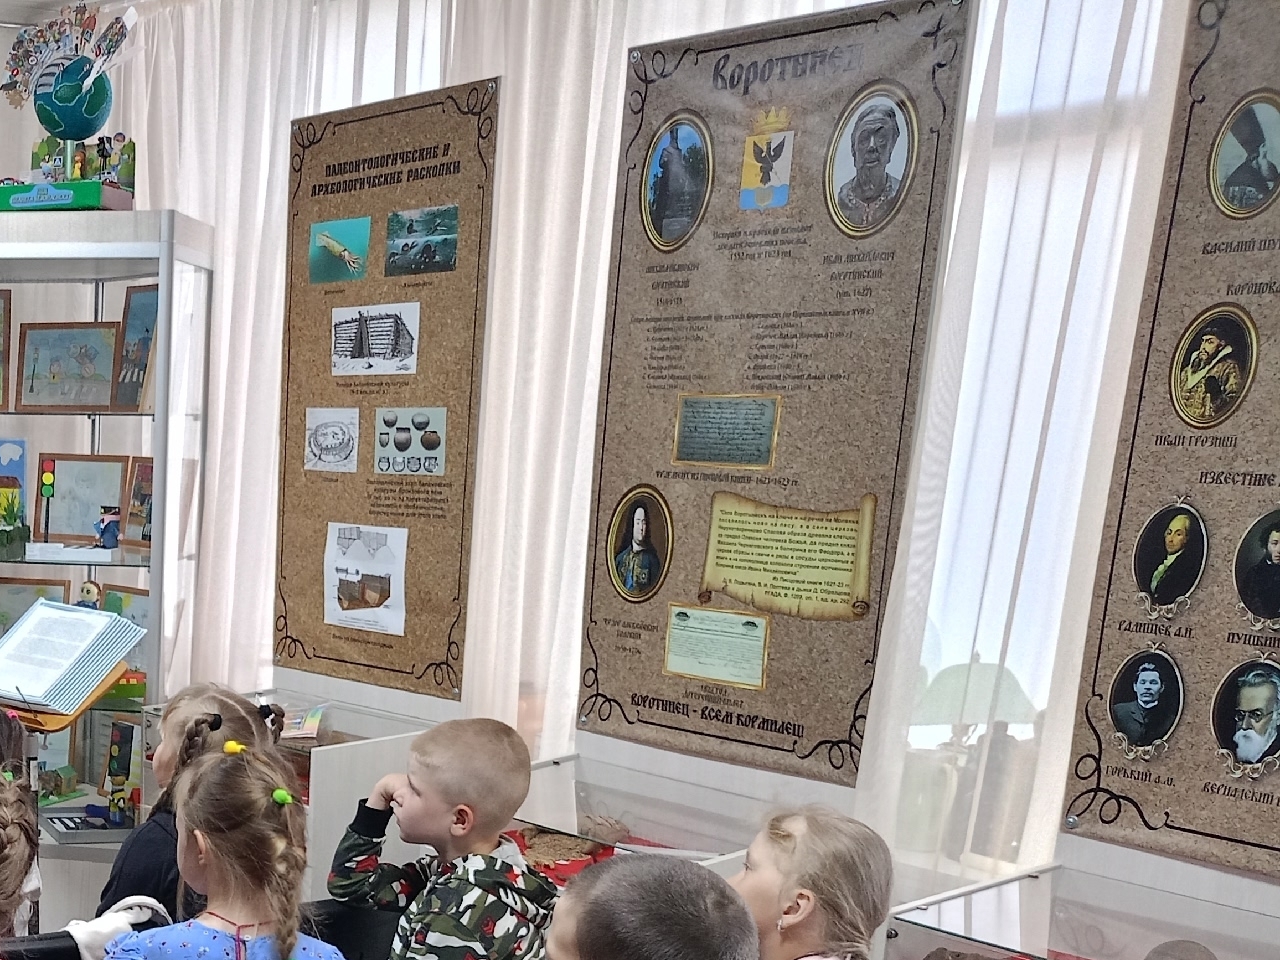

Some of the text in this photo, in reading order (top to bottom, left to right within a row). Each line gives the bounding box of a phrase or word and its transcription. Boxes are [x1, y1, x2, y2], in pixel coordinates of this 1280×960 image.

[325, 143, 451, 177] ПАЛЕОНТОЛОГИЧЕСКИЕ И
[311, 161, 461, 197] АРХЕОЛОГИЧЕСКИЕ РАСКОПКИ
[1201, 238, 1256, 254] ВАСИЛИЙ
[1154, 434, 1238, 448] ИВАН ГРОЗНЫЙ
[1199, 471, 1277, 487] ИЗВЕСТНЫЕ
[1117, 619, 1172, 637] РАДИЩЕВ
[631, 693, 690, 718] ВОРОТЫНЕЦ
[700, 705, 733, 725] ВСЕМ
[736, 714, 804, 738] КОРМИЛЕЦ!
[1105, 765, 1152, 783] ГОРЬКИЙ
